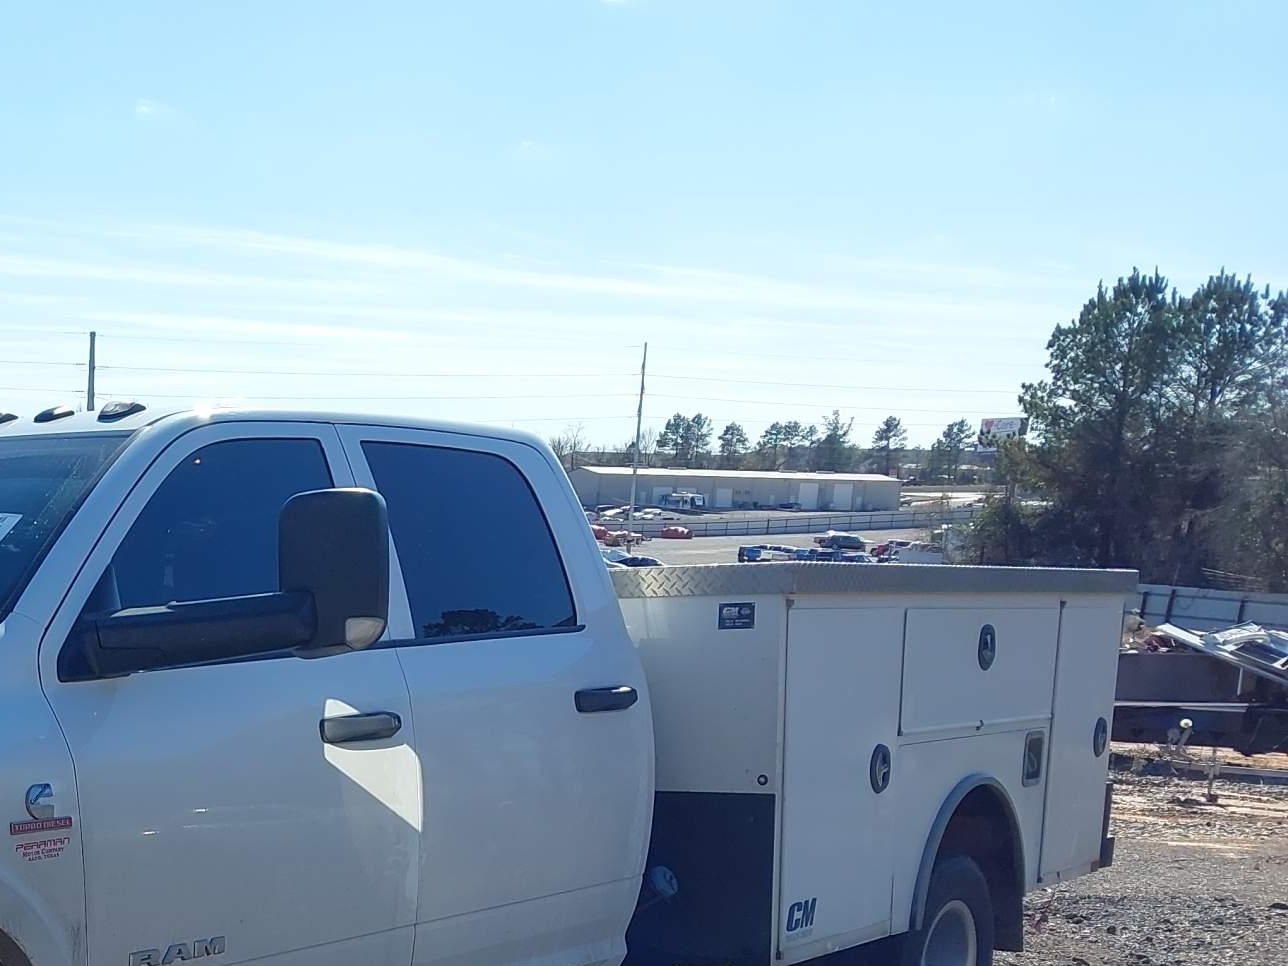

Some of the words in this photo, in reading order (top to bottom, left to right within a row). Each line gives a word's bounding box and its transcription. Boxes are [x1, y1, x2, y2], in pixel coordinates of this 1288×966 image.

[14, 822, 42, 831] TURBO
[43, 819, 70, 829] DIESEL
[786, 898, 817, 932] CM
